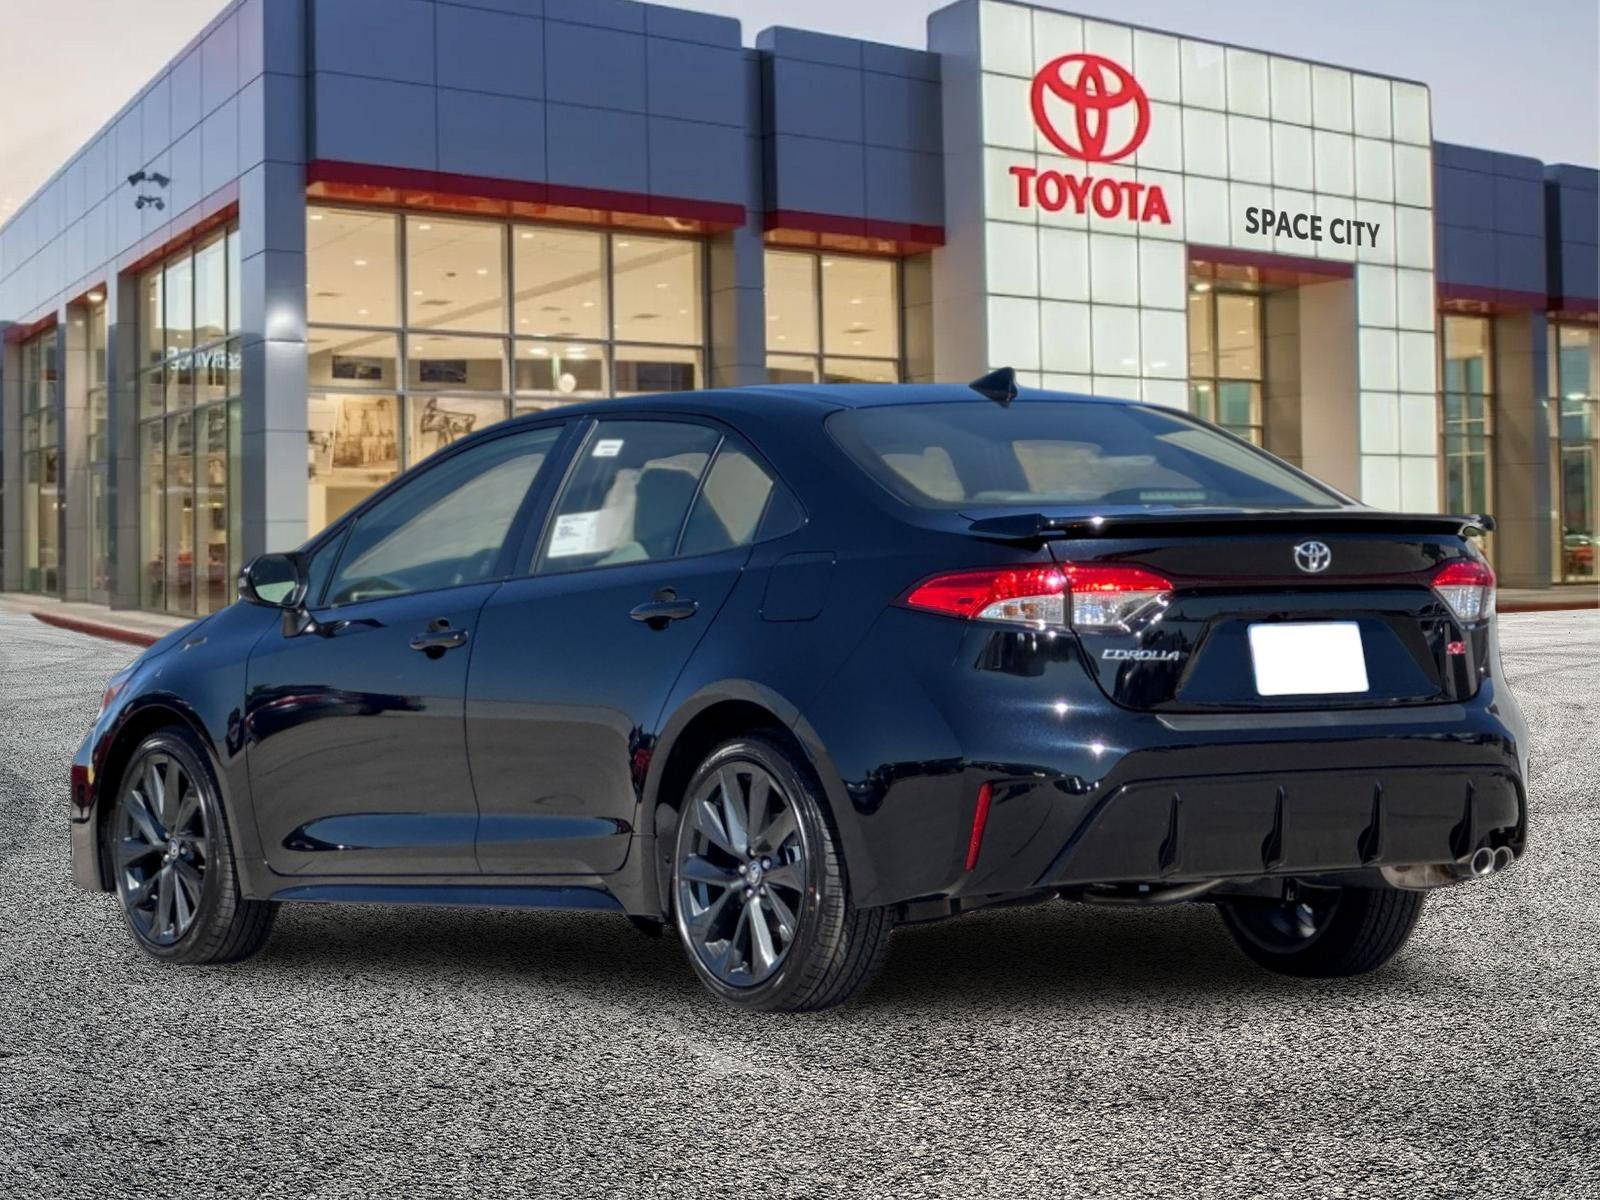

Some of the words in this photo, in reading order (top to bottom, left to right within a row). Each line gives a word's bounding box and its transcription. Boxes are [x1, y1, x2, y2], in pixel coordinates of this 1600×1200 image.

[1009, 166, 1171, 224] TOYOTA
[1245, 206, 1323, 241] SPACE
[1329, 218, 1381, 248] CITY
[1101, 648, 1180, 661] COROLLA
